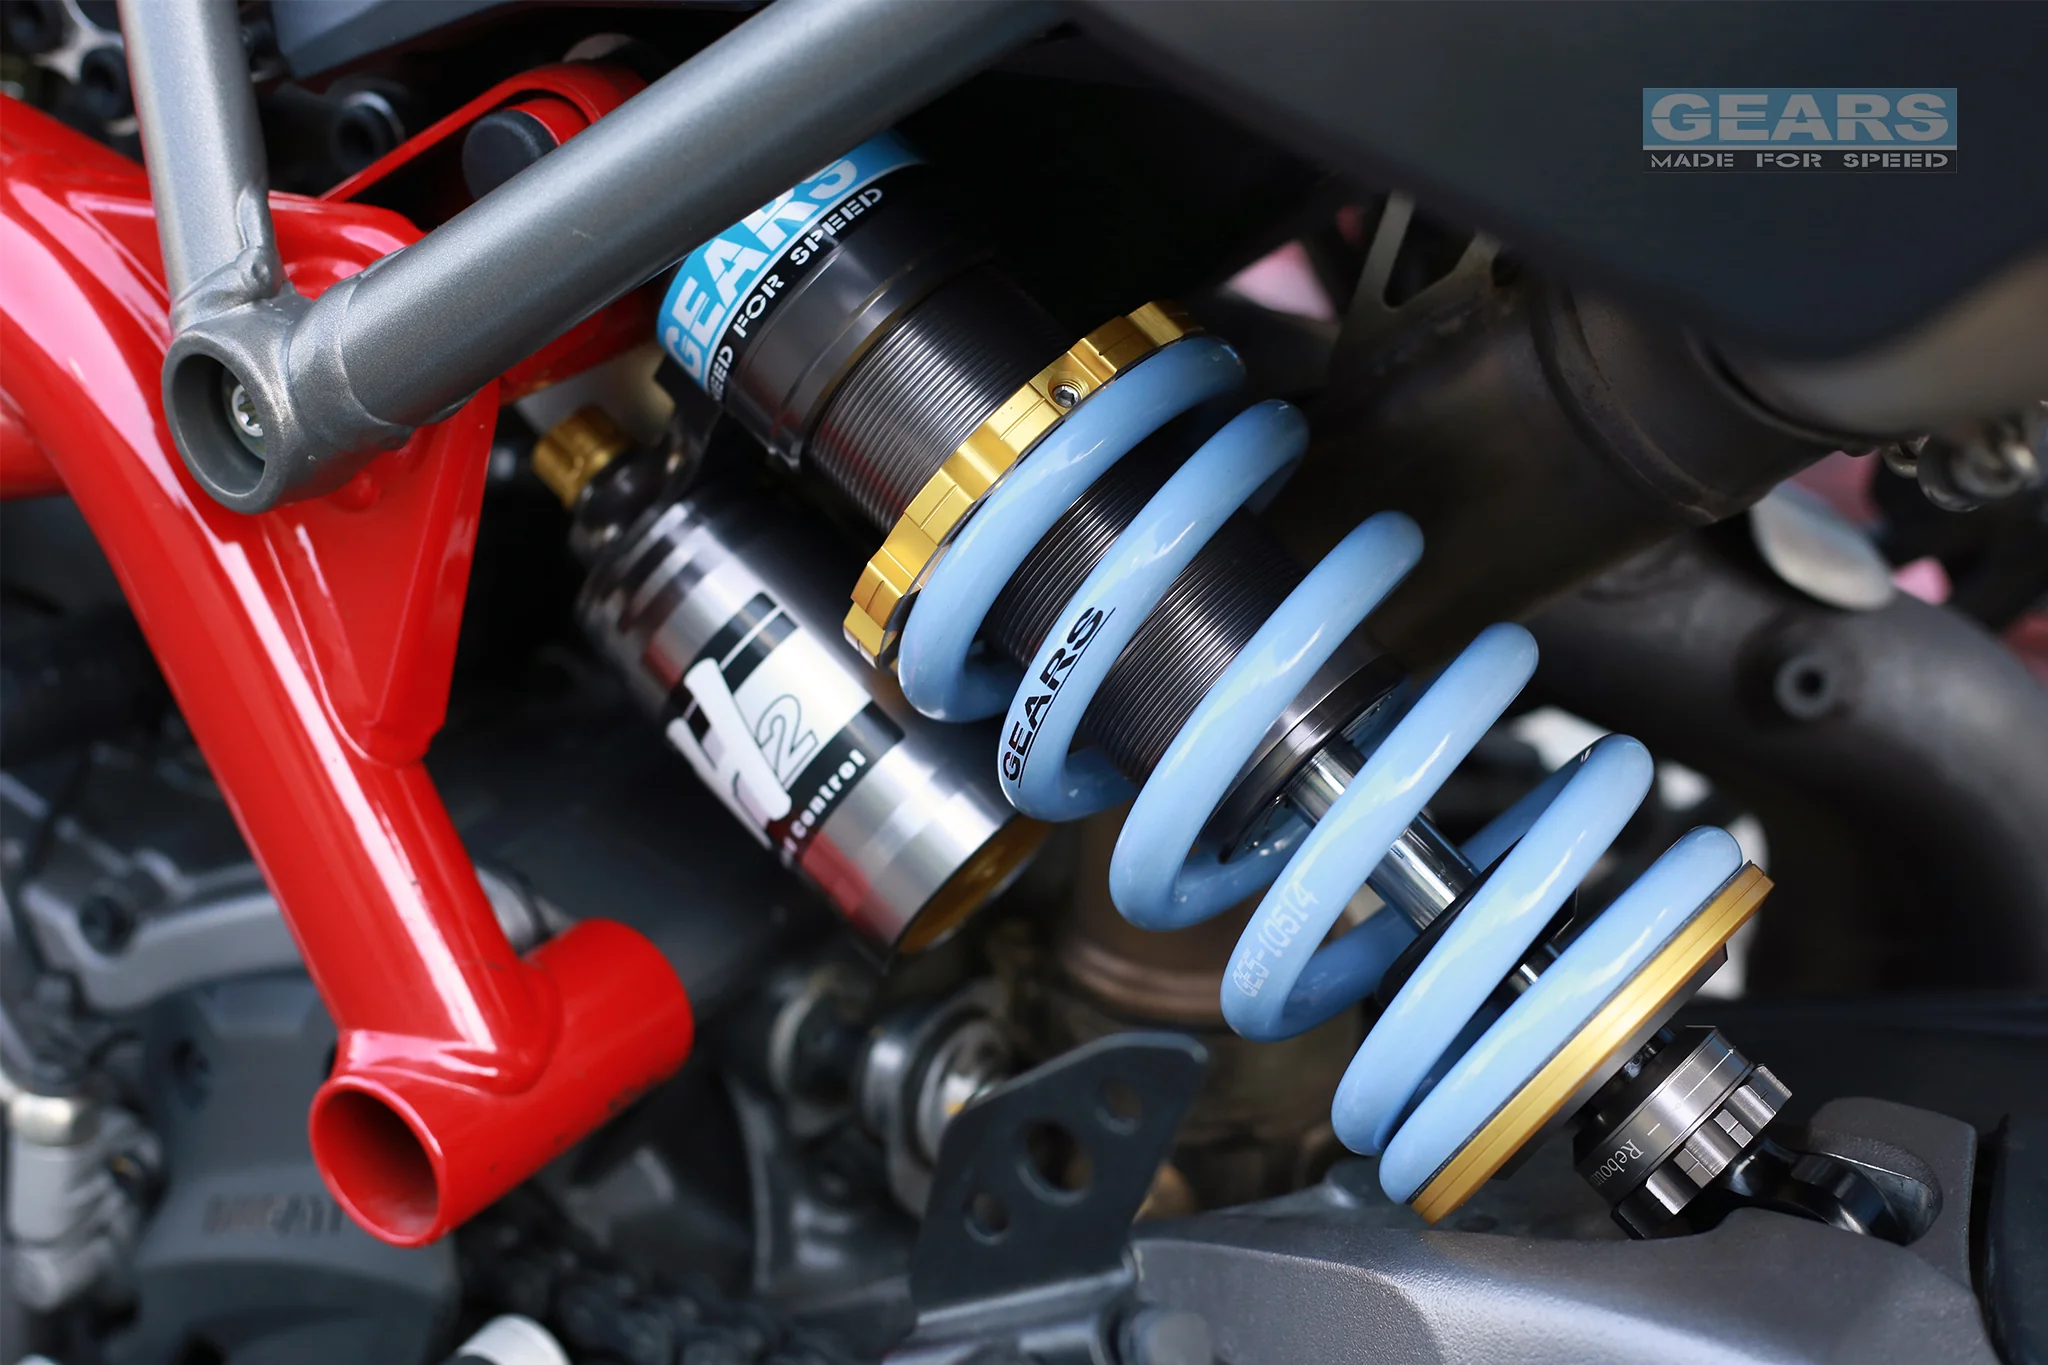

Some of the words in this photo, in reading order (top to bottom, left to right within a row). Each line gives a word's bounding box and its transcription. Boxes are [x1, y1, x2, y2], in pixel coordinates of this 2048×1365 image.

[733, 273, 785, 338] FOR
[790, 187, 883, 265] SPEED
[1003, 607, 1104, 781] GEARS
